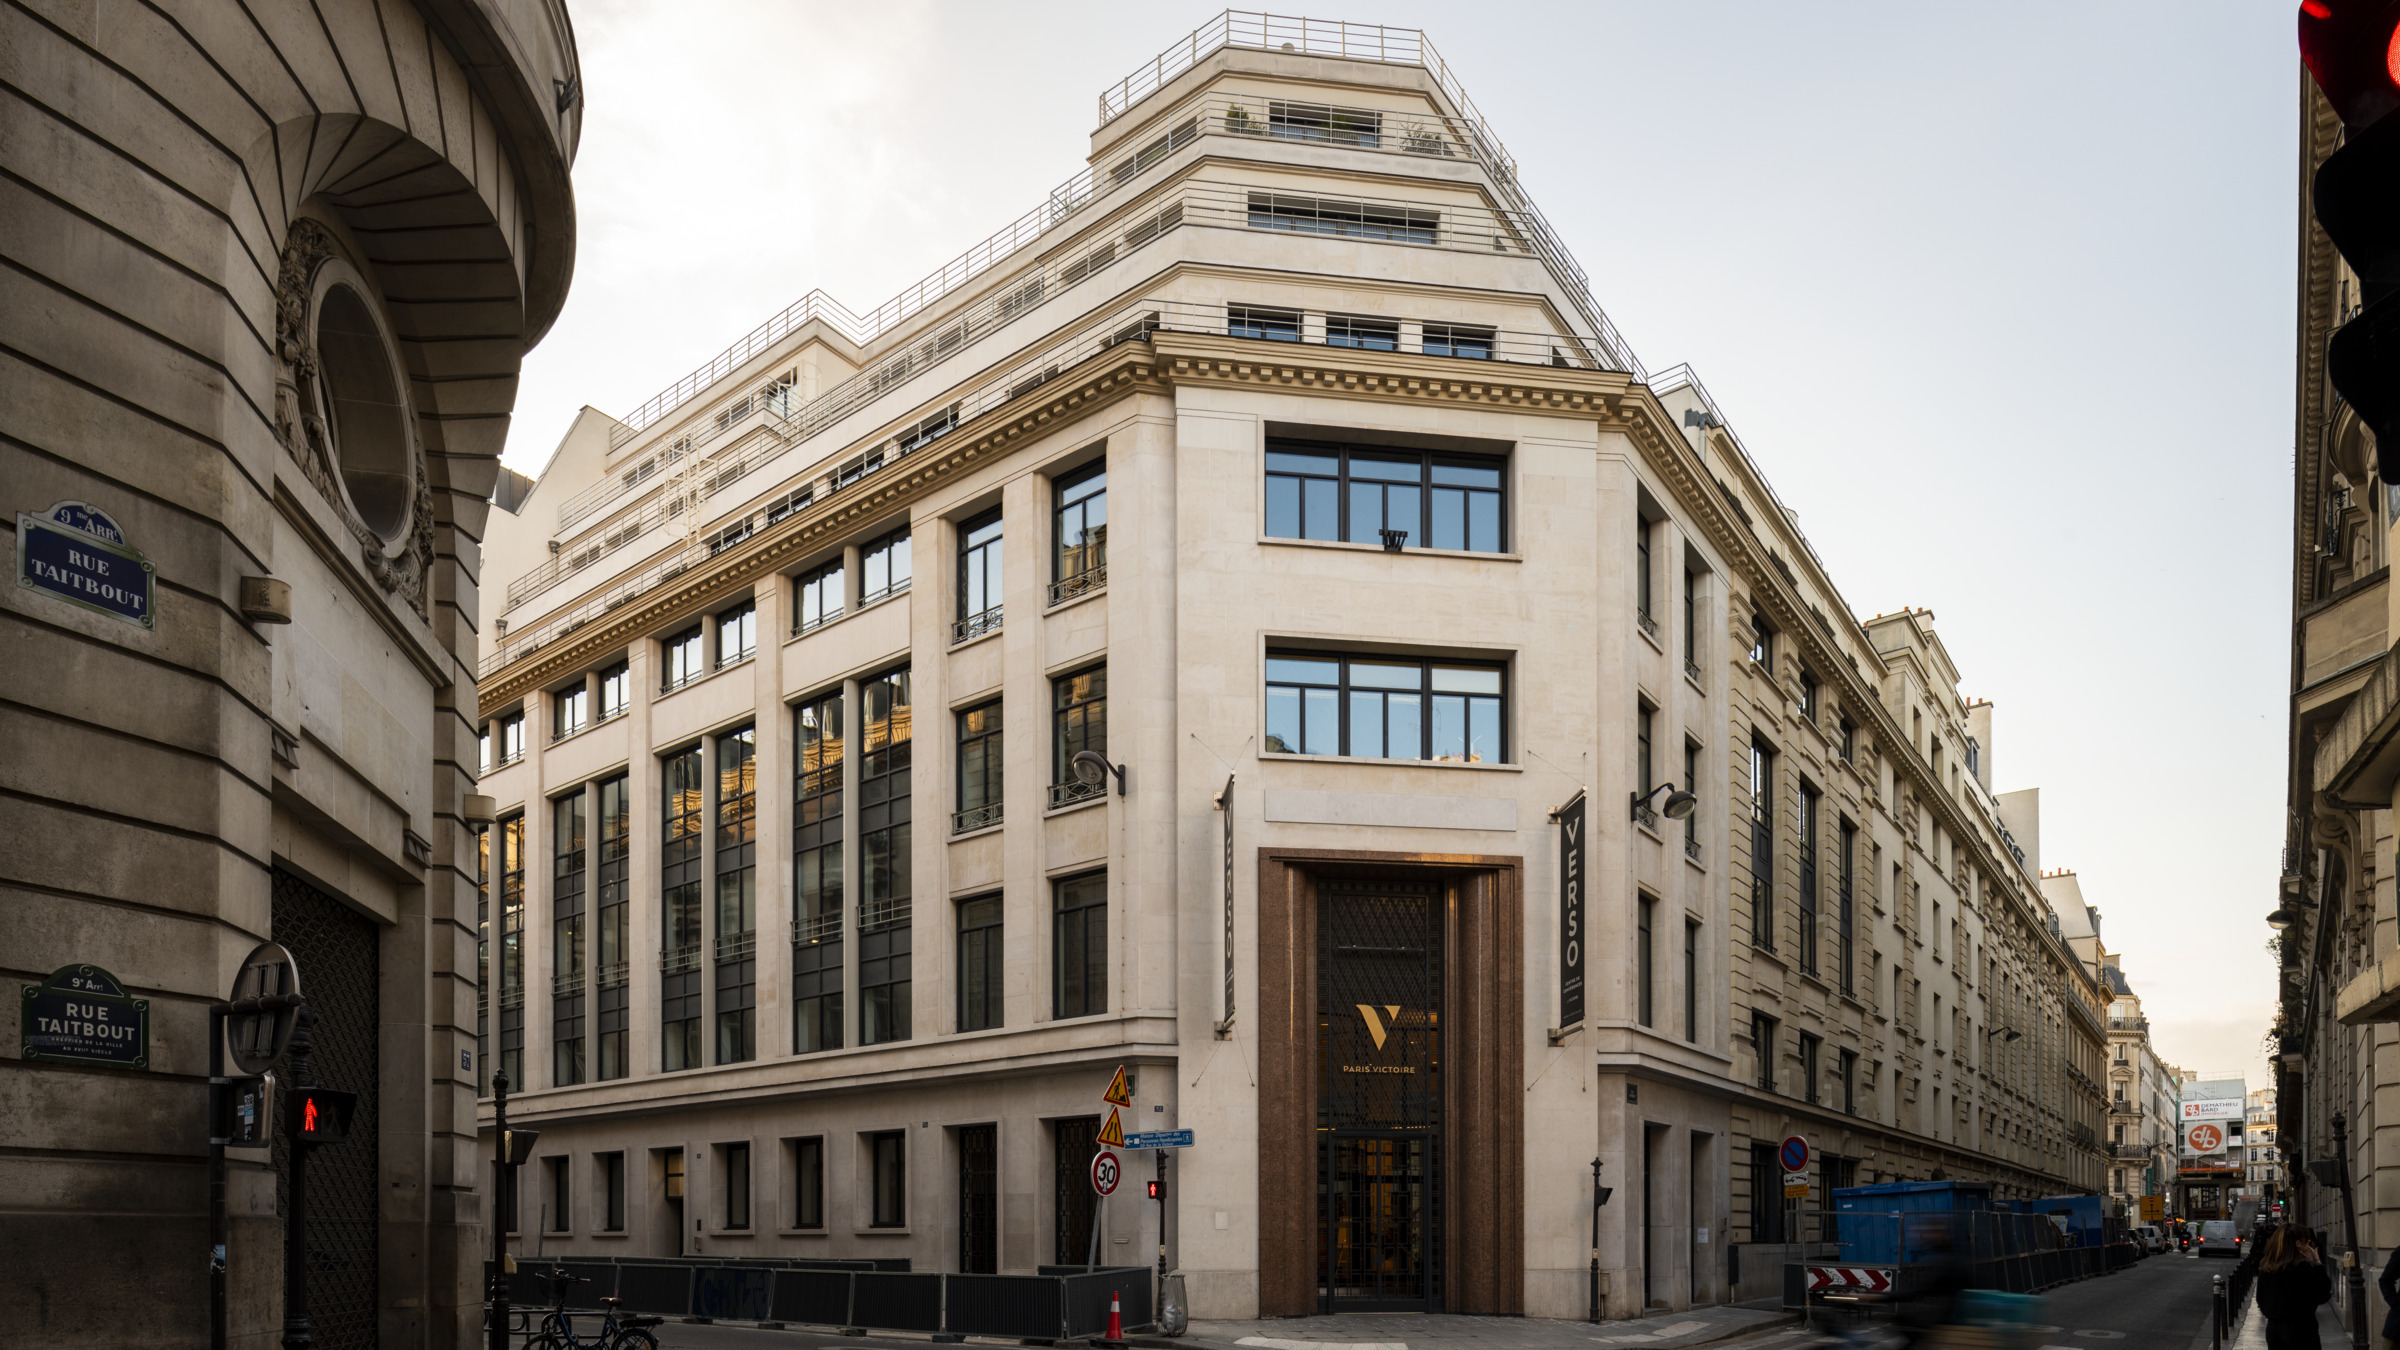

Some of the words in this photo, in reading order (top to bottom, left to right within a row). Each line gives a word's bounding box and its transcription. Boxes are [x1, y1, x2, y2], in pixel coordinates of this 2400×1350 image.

[68, 549, 109, 576] RUE
[31, 558, 143, 610] TAITBOUT
[1565, 816, 1580, 968] VERSO
[66, 1002, 109, 1021] RUE
[38, 1017, 135, 1041] TAITBOUT
[1343, 1065, 1370, 1073] PARIS
[1372, 1066, 1415, 1074] VICTOIRE
[1098, 1162, 1116, 1185] 30
